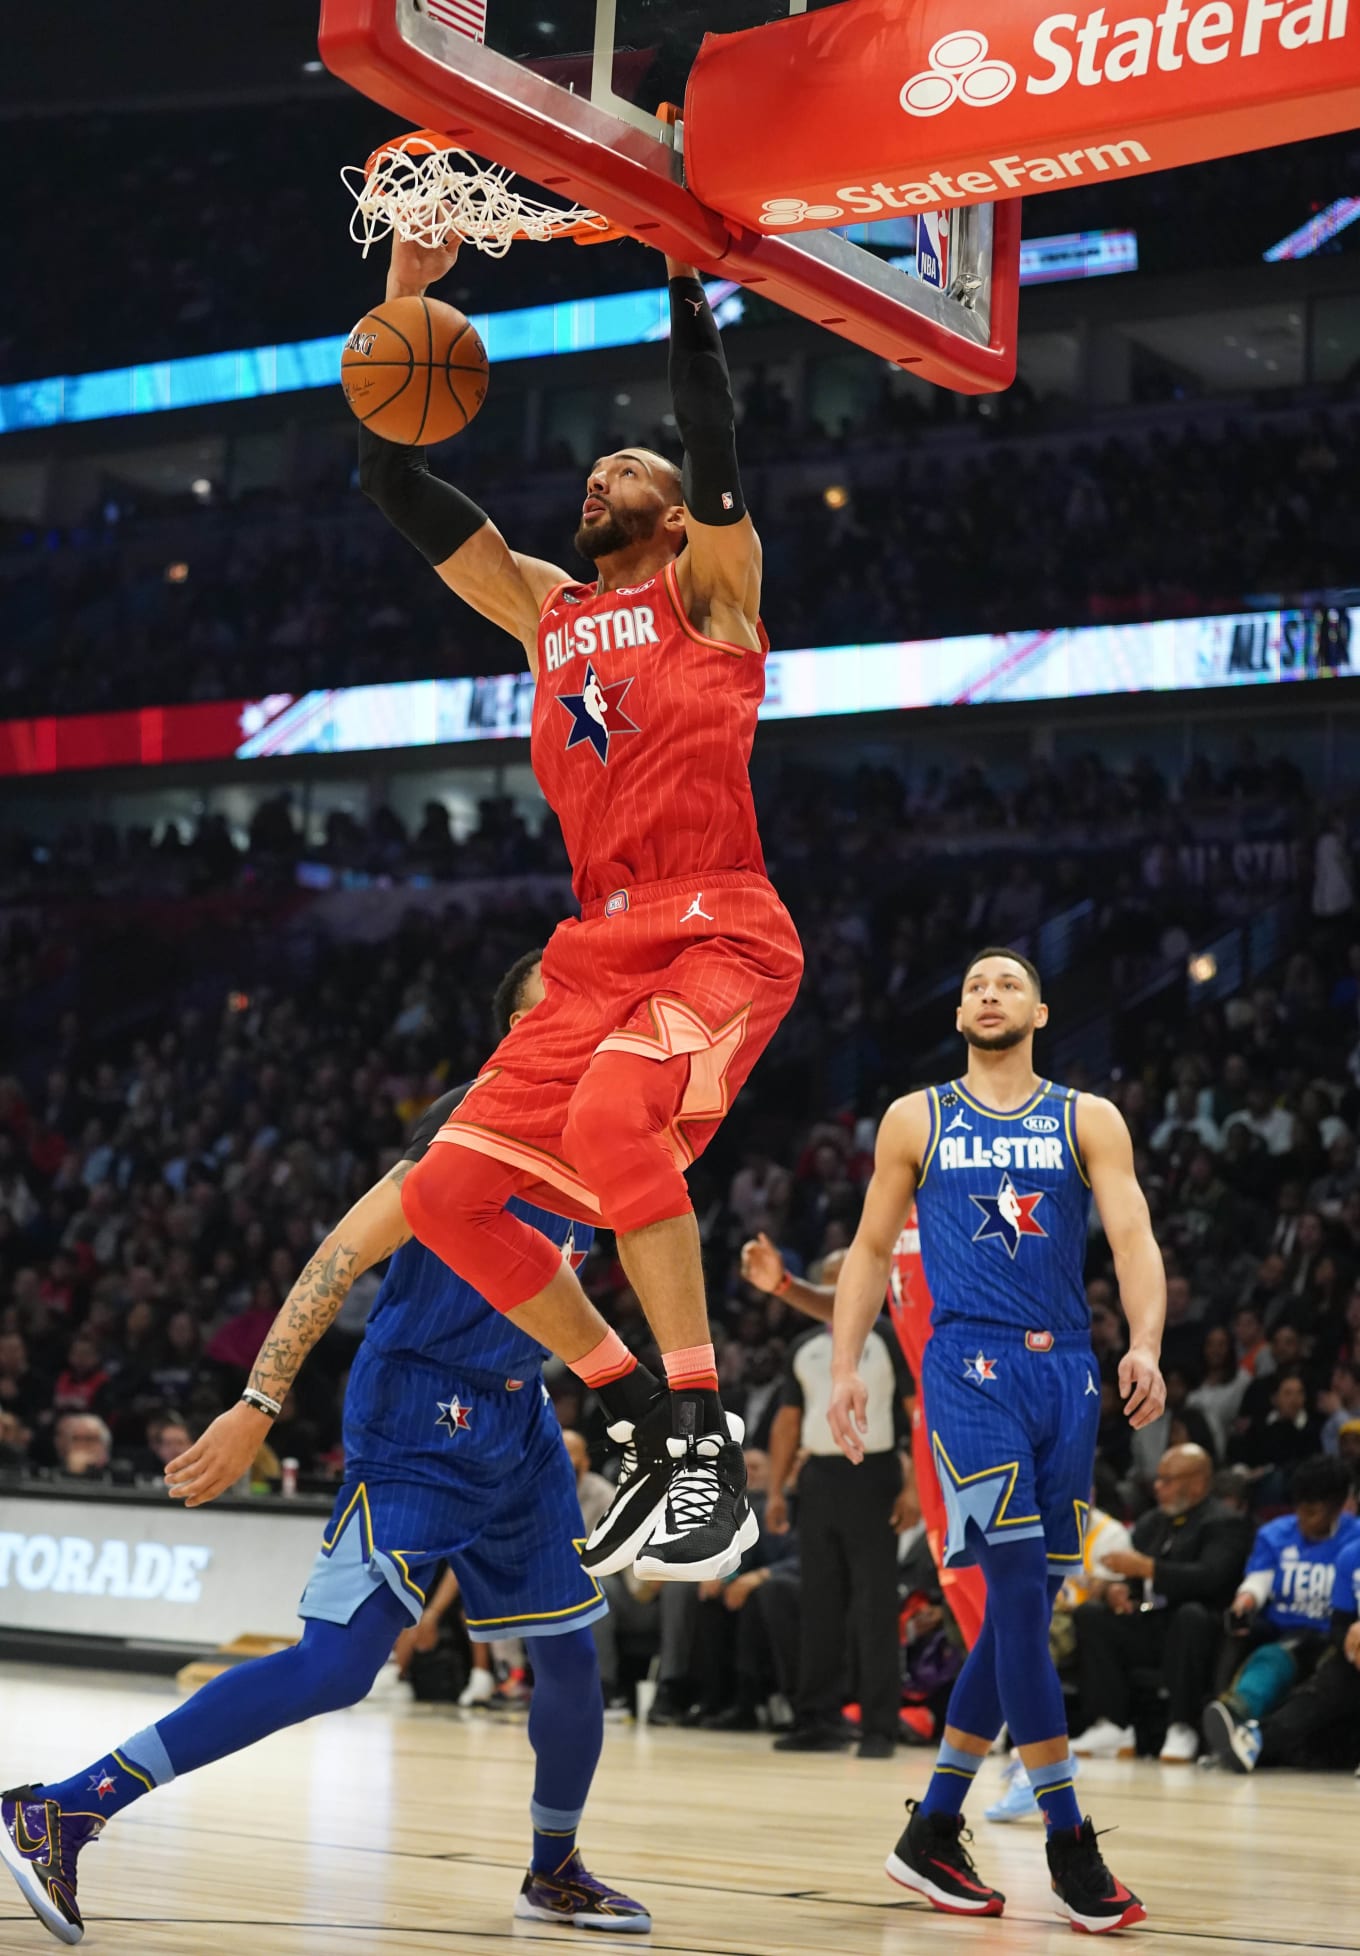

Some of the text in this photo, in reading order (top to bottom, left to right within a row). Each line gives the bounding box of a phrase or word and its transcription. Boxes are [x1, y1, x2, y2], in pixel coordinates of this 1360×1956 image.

[920, 251, 937, 280] NBA
[544, 604, 661, 673] ALL-STAR
[1028, 1118, 1054, 1131] KIA
[939, 1136, 1064, 1170] ALL-STAR
